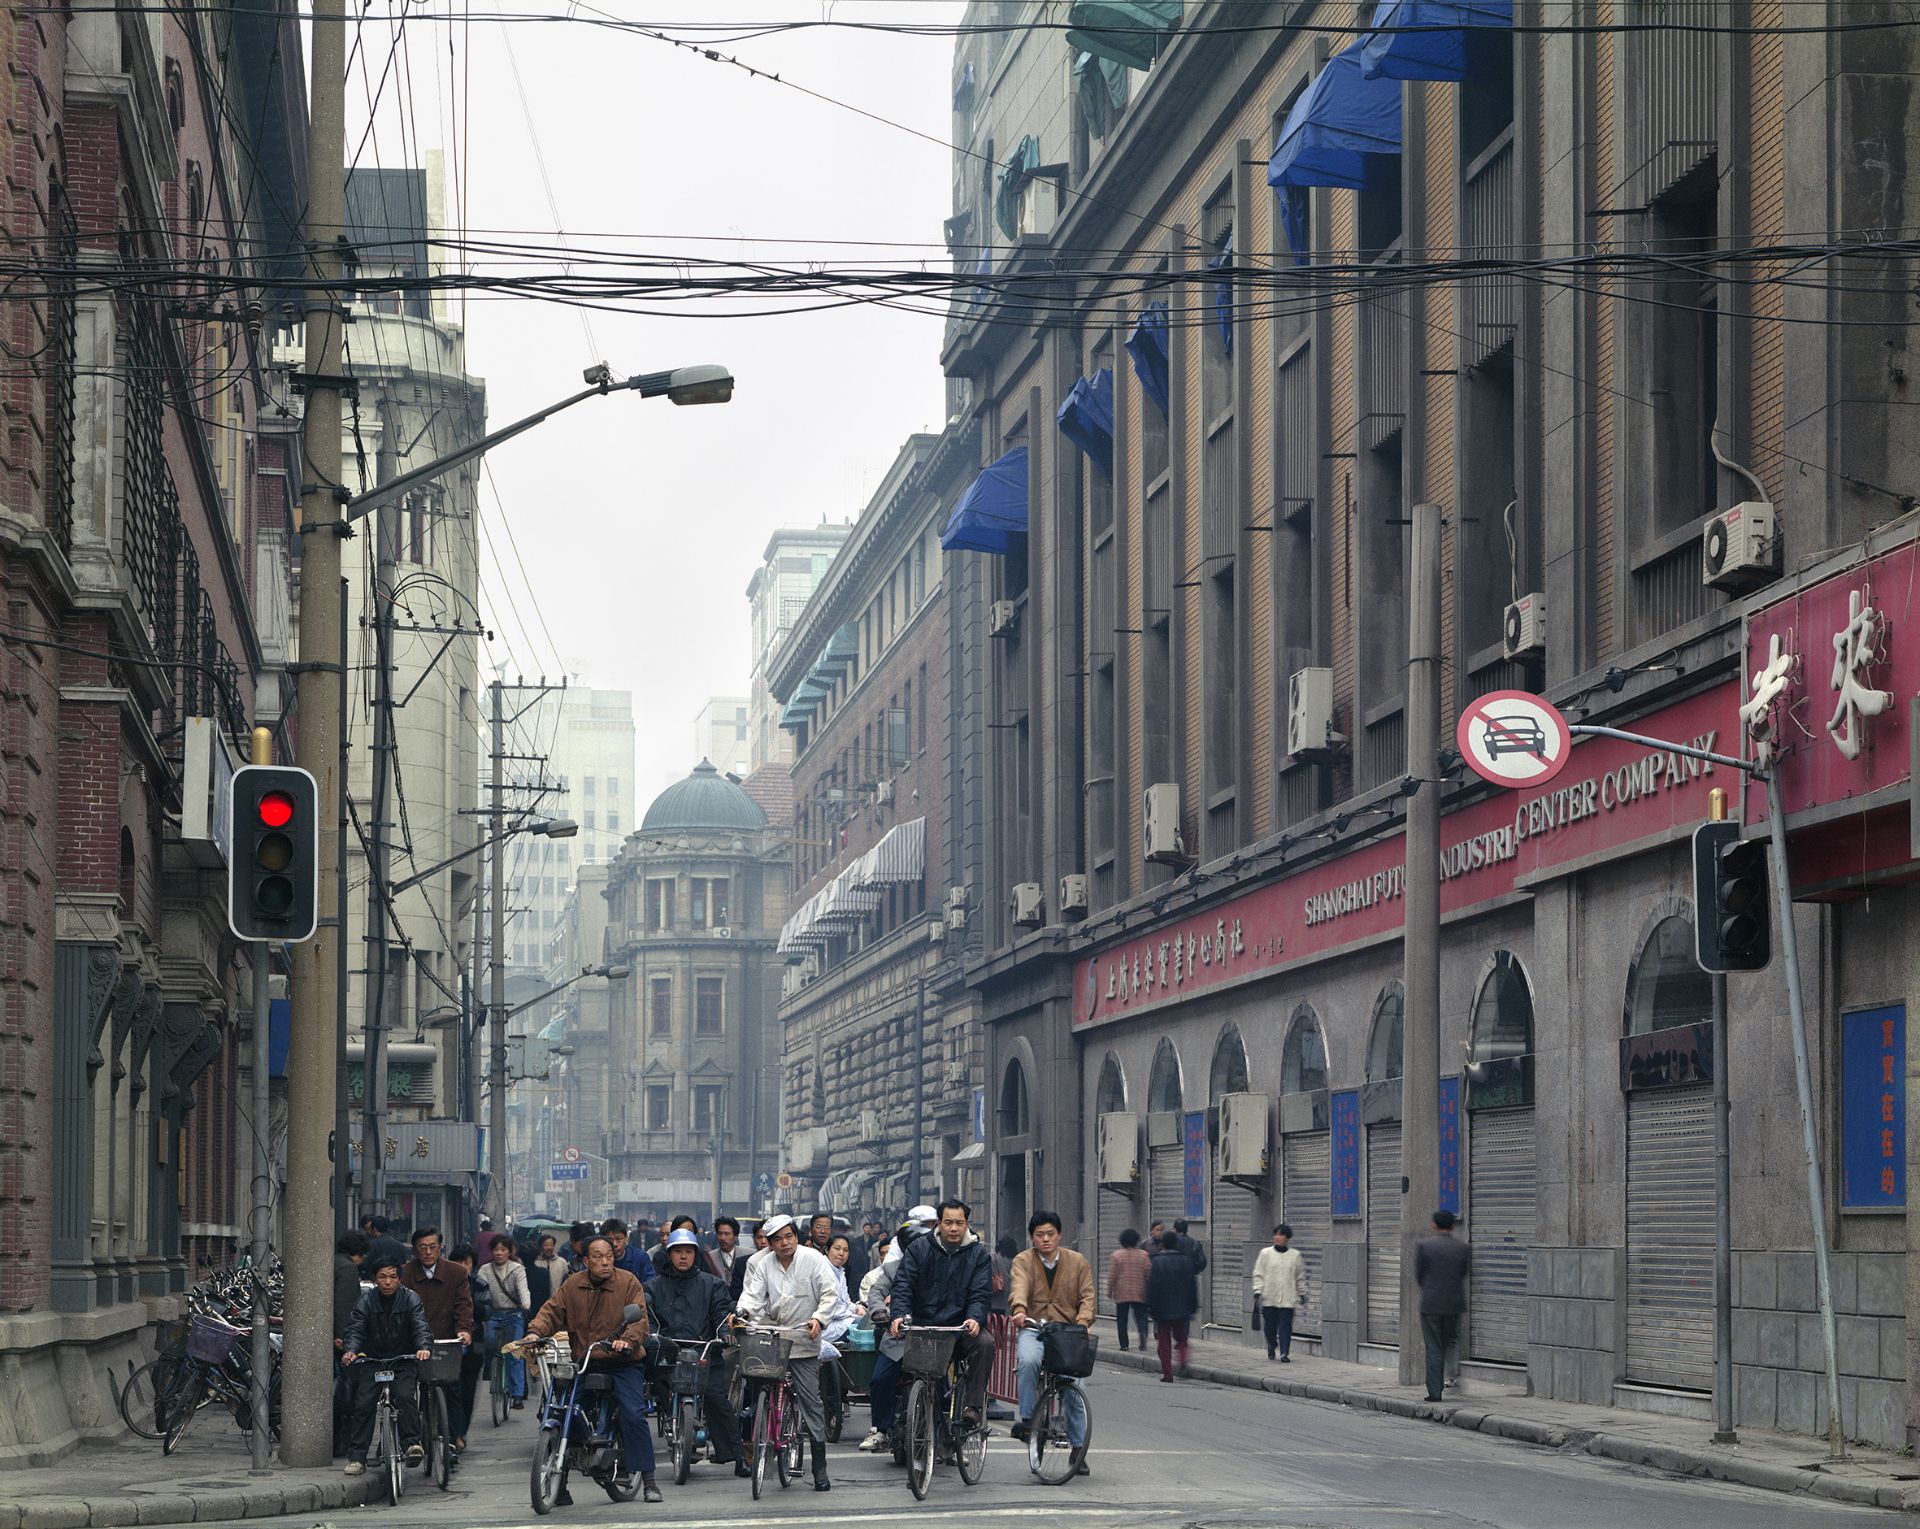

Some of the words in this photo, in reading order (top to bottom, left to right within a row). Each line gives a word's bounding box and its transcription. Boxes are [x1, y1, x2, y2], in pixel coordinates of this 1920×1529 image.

[1305, 876, 1373, 926] SHANGHAI
[1514, 779, 1598, 840] CENTER
[1602, 730, 1717, 810] COMPANY
